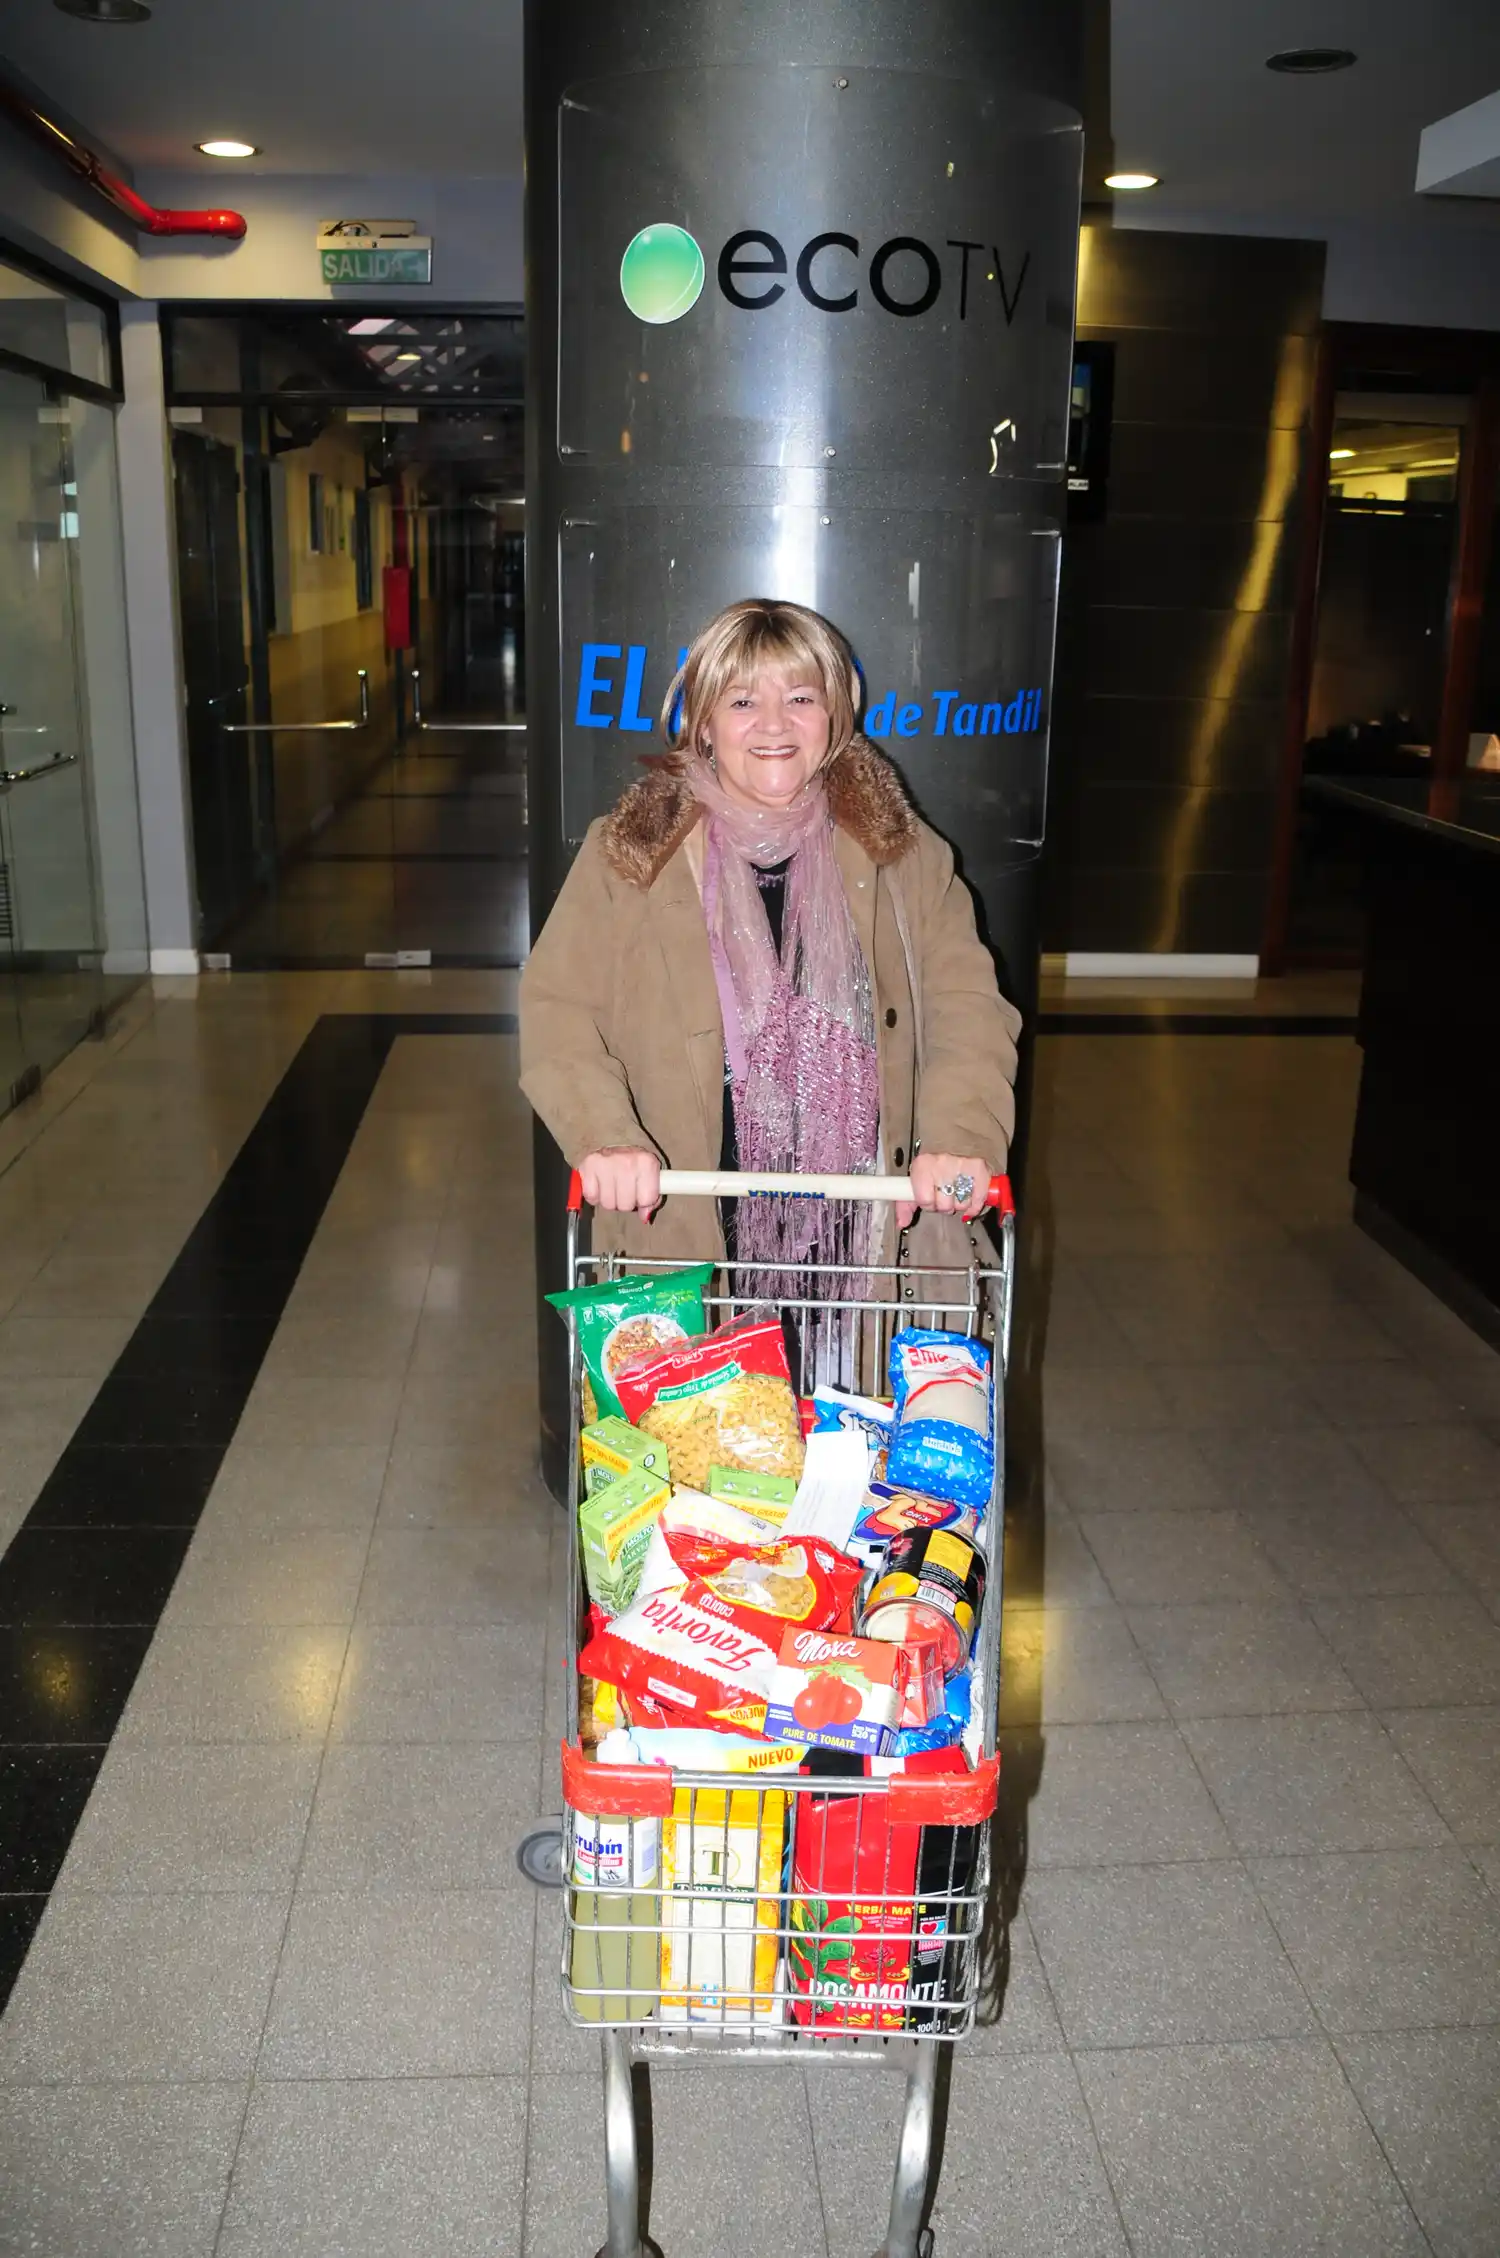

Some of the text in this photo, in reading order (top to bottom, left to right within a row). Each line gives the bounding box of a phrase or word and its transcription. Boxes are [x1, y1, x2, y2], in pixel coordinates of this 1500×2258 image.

[324, 253, 404, 279] SALIDA
[575, 642, 655, 733] EL
[865, 691, 923, 738] de
[931, 687, 1043, 738] Tandil
[641, 1598, 767, 1671] Favorita
[782, 1727, 856, 1750] PURE DE TOMATE
[747, 1747, 794, 1769] NUEVO
[846, 1903, 927, 1916] YERBA MAE
